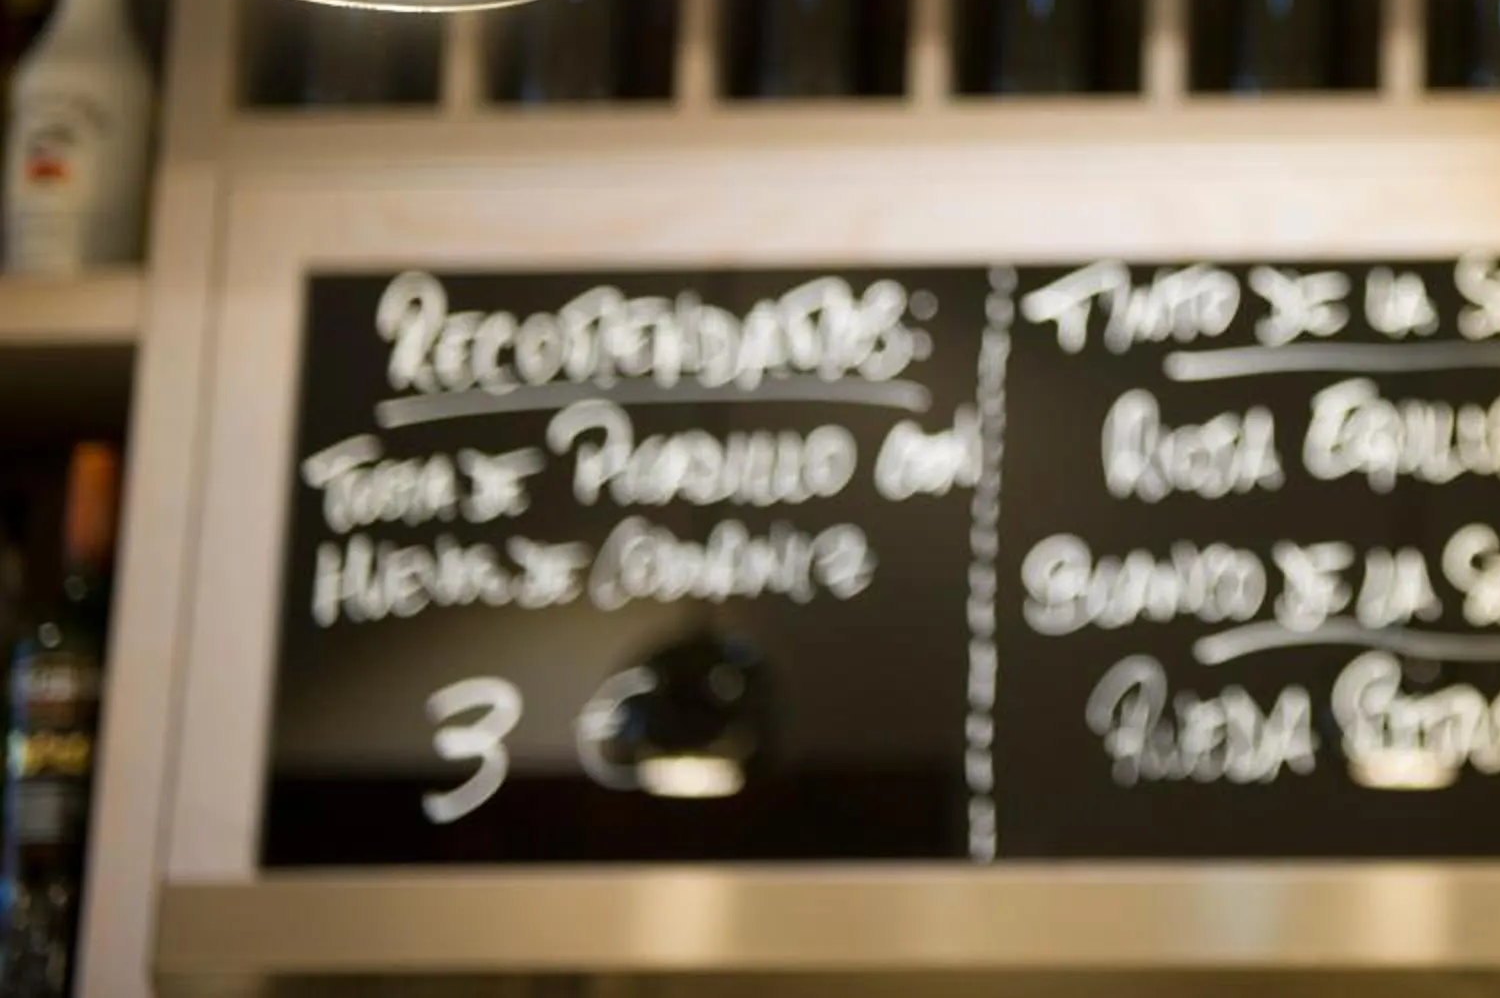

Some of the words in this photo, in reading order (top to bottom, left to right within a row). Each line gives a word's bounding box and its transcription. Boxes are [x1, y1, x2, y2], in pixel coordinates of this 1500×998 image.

[1249, 265, 1352, 347] DE
[1363, 264, 1439, 337] LA
[1273, 539, 1356, 632] DE
[1356, 545, 1444, 629] LA
[421, 676, 524, 825] 3
